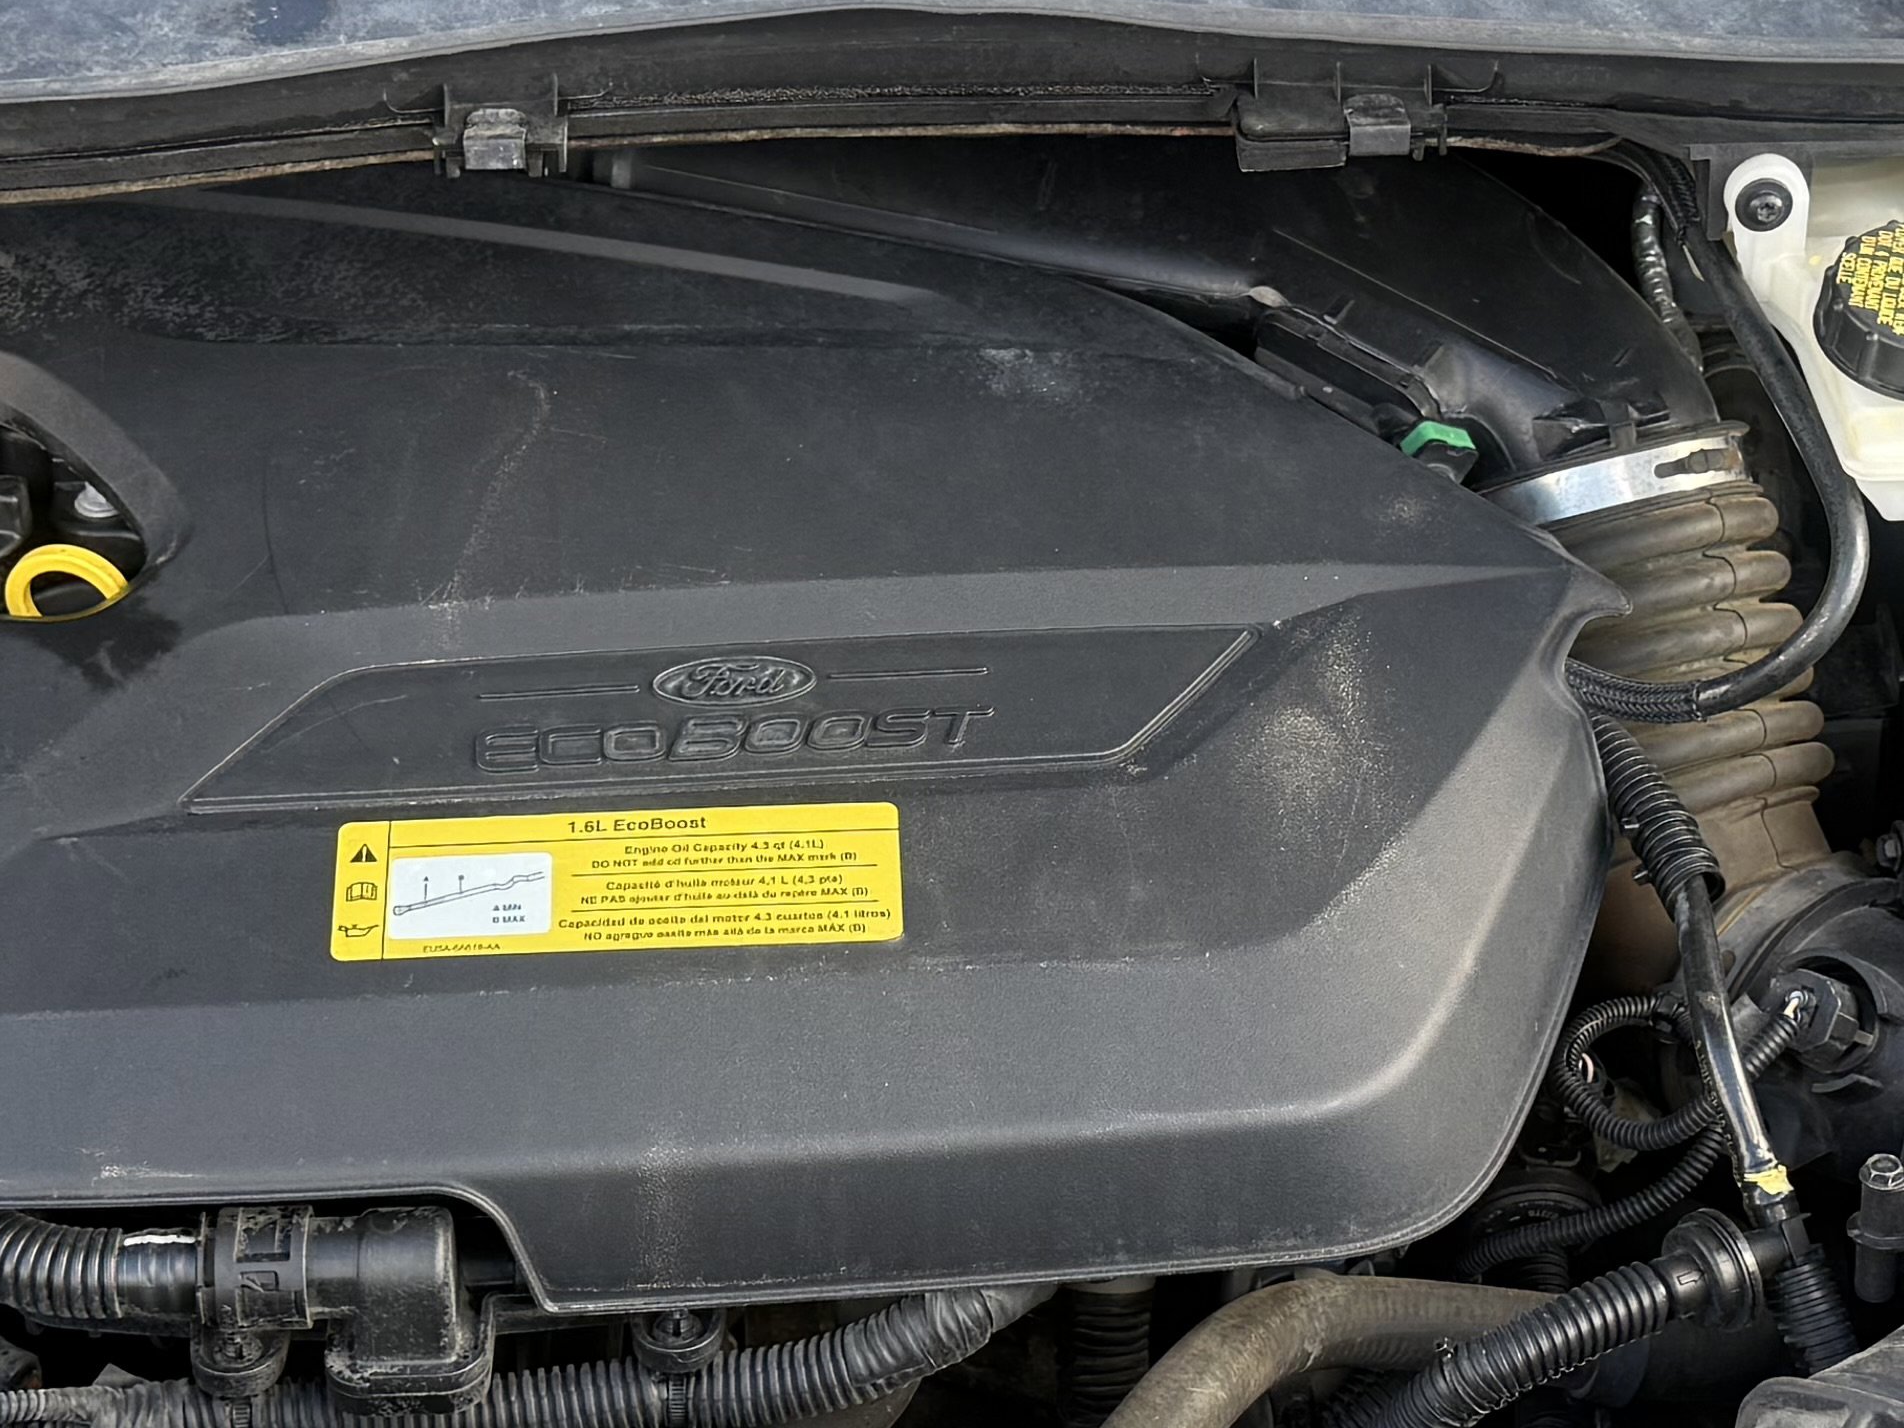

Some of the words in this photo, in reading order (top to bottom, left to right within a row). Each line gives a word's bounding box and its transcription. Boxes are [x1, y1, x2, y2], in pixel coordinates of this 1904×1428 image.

[679, 660, 786, 698] Ford
[474, 706, 996, 773] ECOBOOST
[568, 821, 607, 833] 1.6L
[614, 817, 707, 831] EcoBoost
[624, 845, 668, 855] Engine
[693, 842, 747, 852] Capacity
[592, 860, 610, 868] DO
[613, 859, 638, 867] NOT
[777, 853, 804, 862] MAX
[821, 887, 848, 896] MAX
